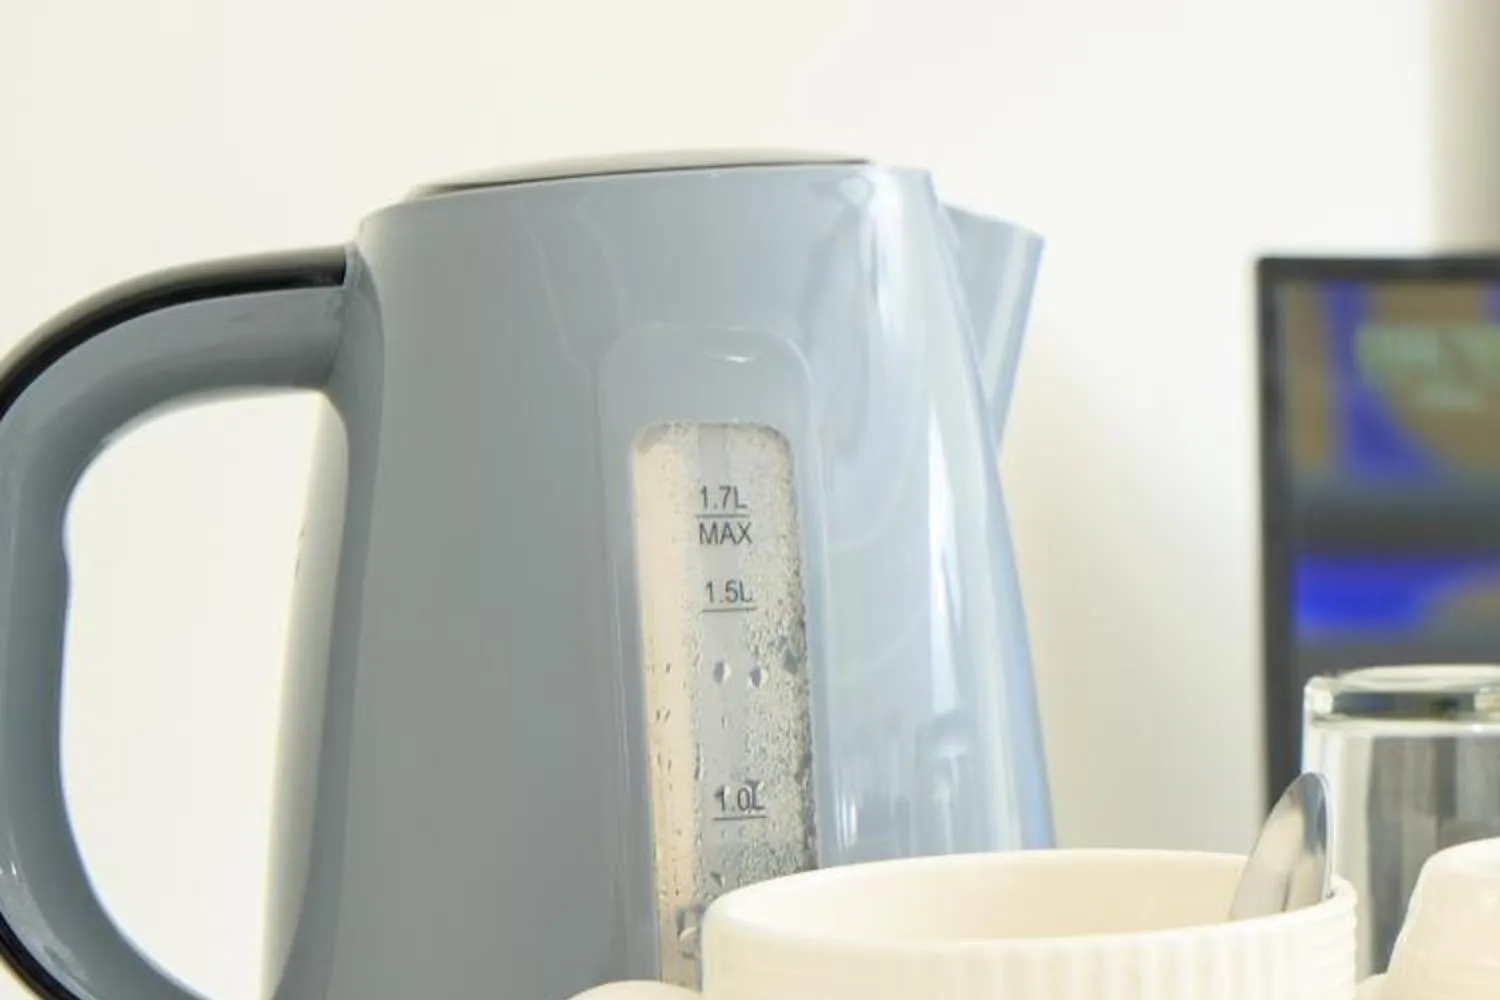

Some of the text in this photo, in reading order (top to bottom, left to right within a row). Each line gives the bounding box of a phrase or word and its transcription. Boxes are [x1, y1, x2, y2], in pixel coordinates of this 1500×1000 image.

[699, 486, 748, 510] 1.7L
[698, 522, 753, 545] MAX
[705, 581, 754, 603] 1.5L
[715, 781, 765, 814] 1.0L
